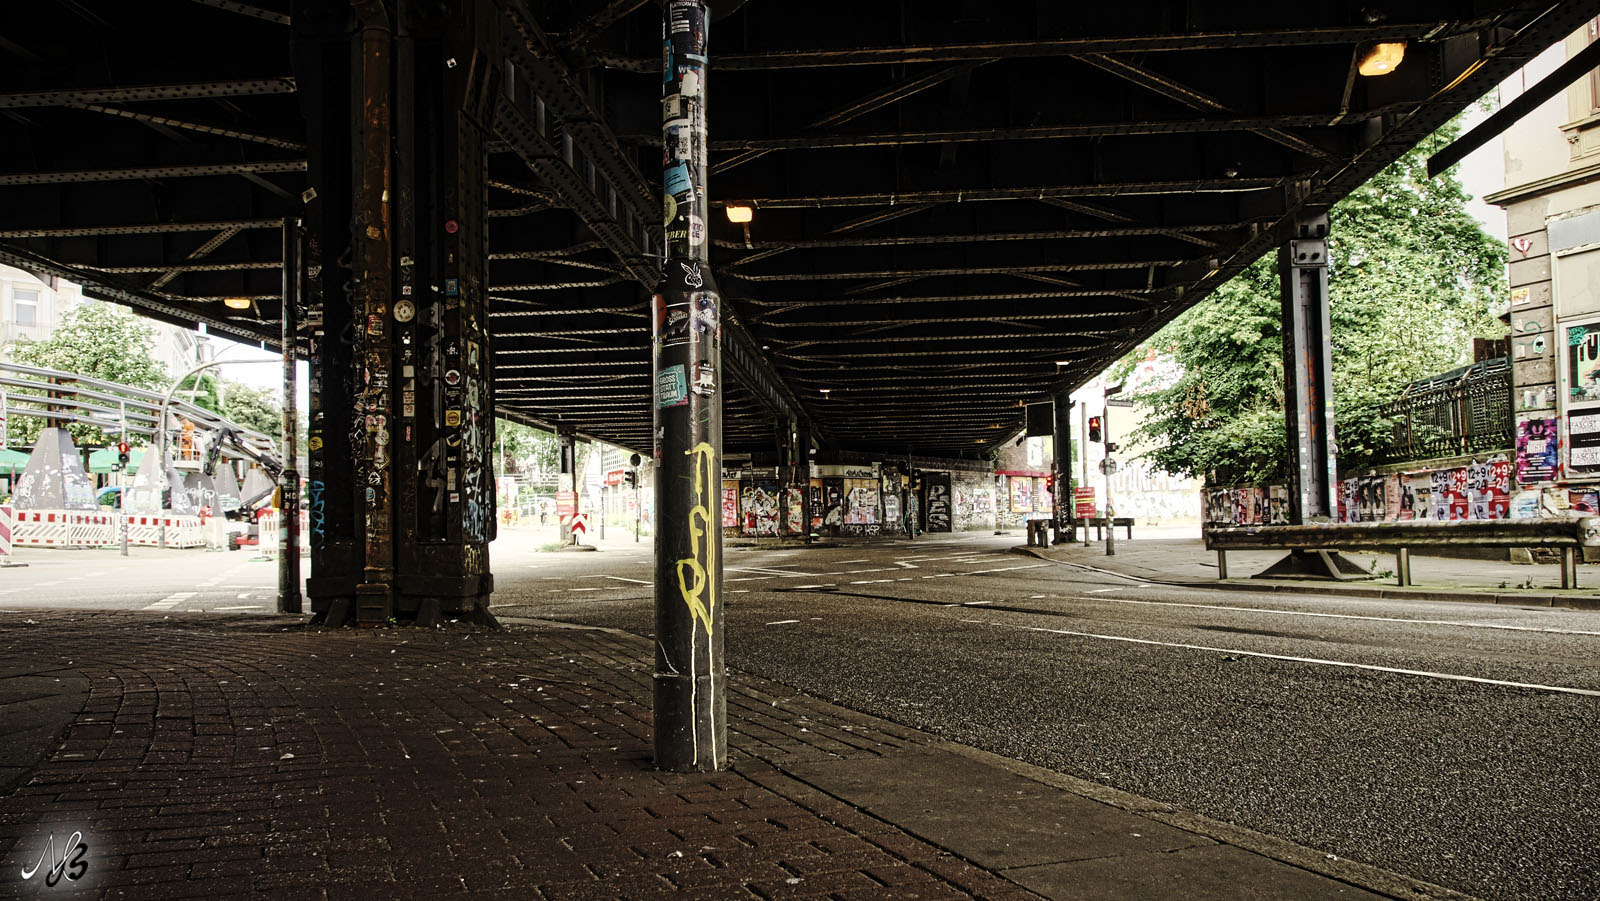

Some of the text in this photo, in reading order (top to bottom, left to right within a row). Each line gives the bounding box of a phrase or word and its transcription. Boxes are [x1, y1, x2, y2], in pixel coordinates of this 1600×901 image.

[1468, 467, 1487, 479] 12+9
[1488, 464, 1508, 477] 12+9
[1468, 480, 1487, 490] =24
